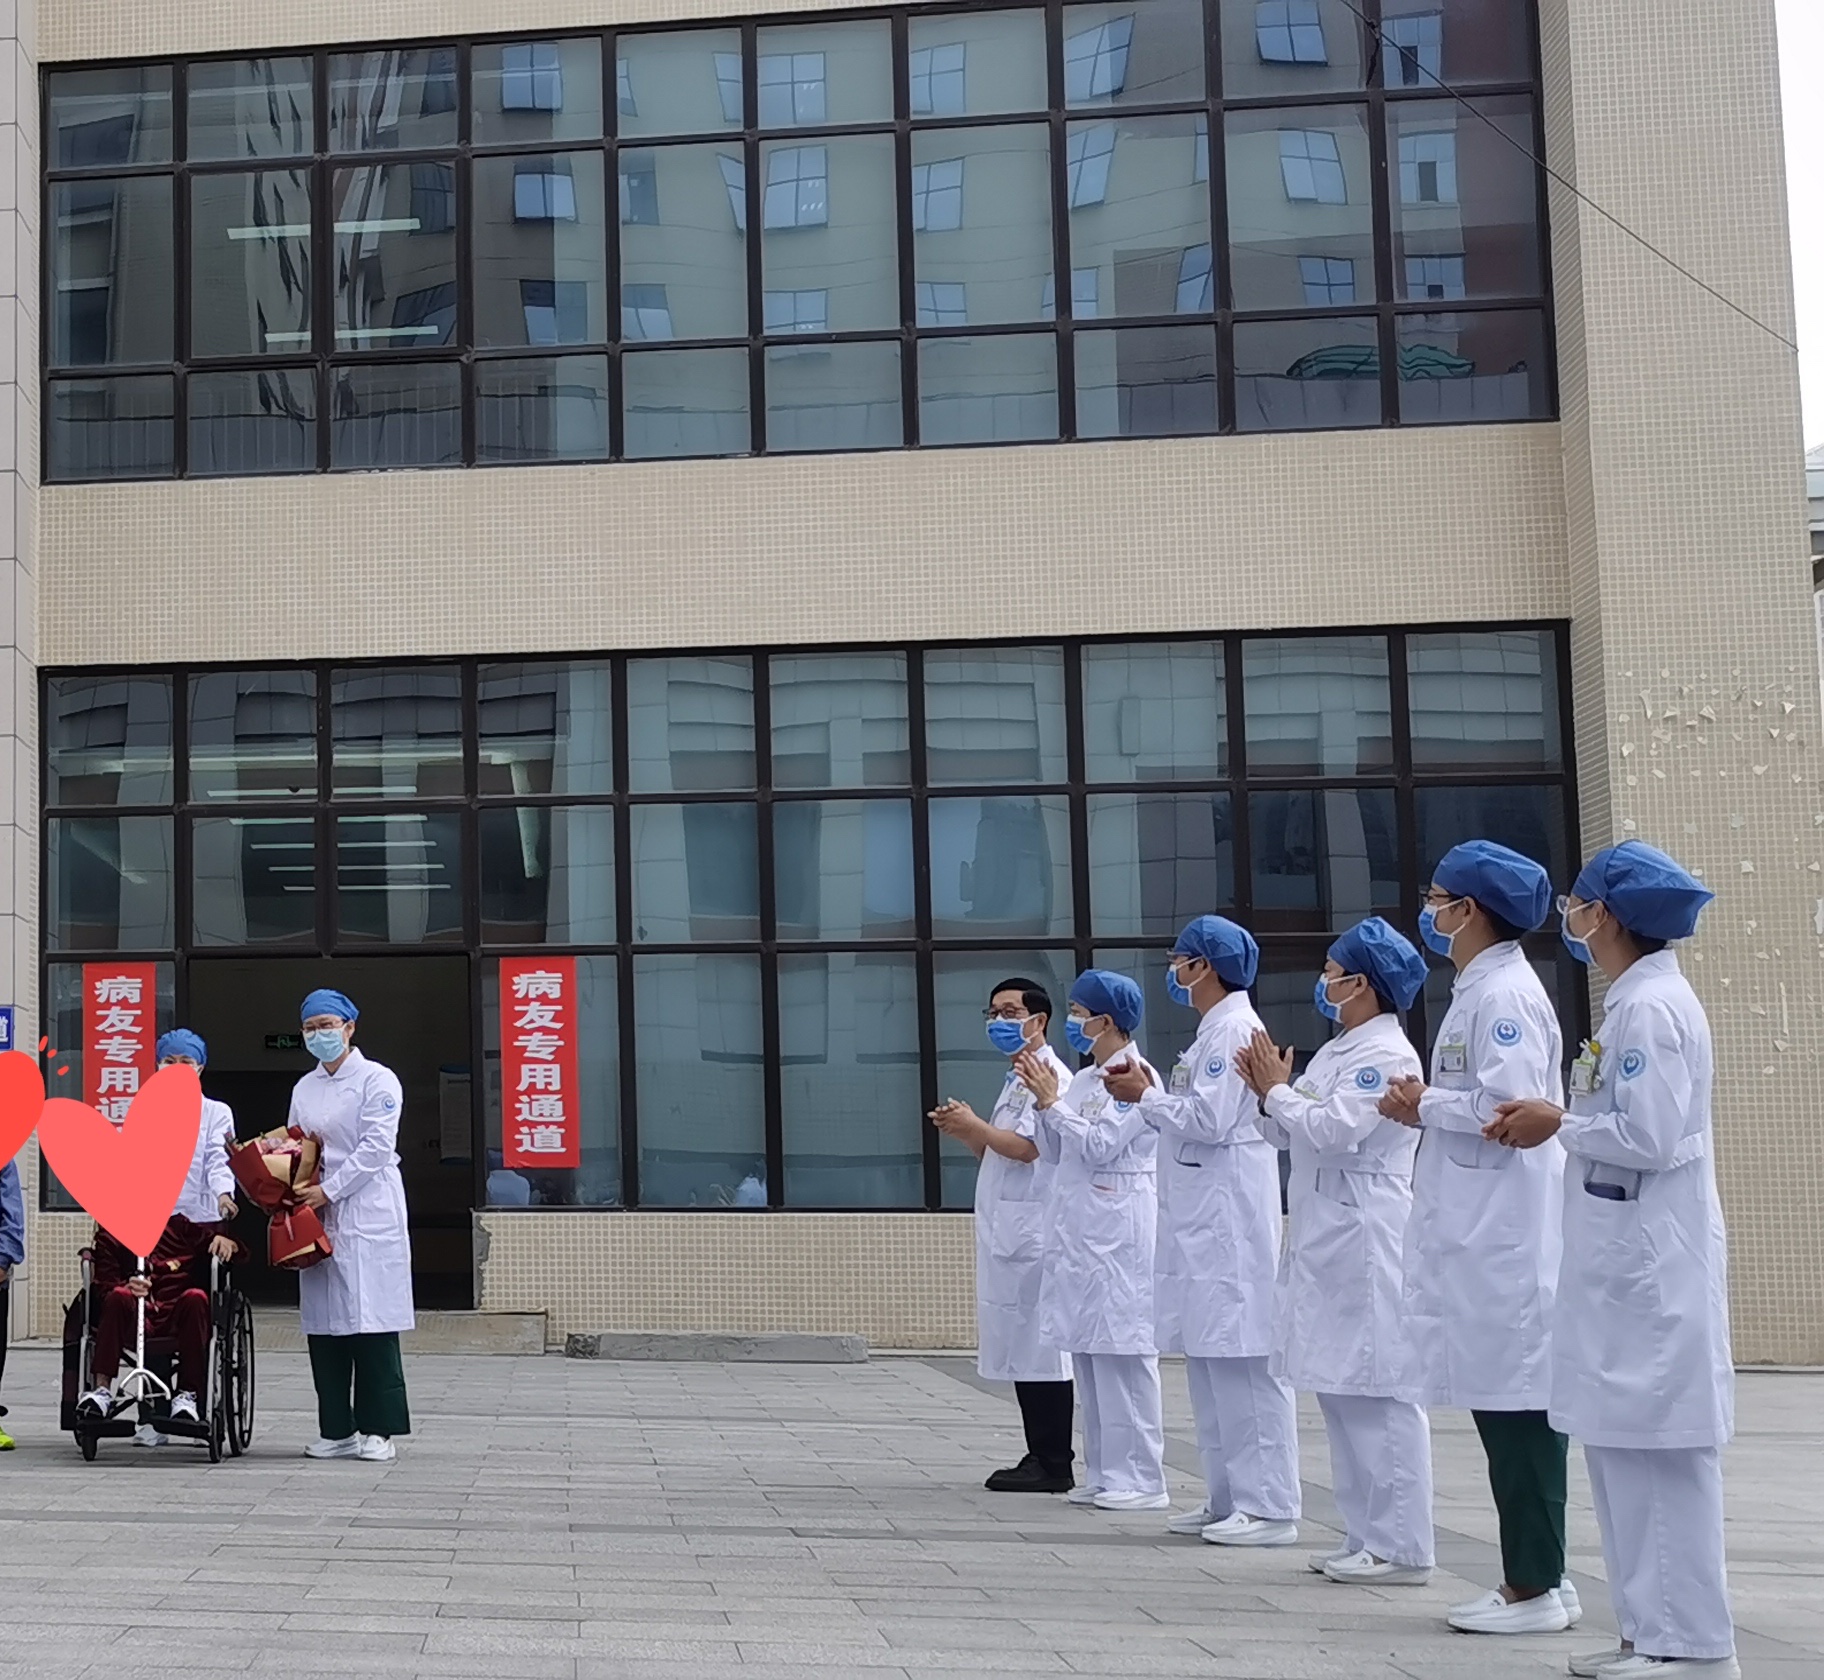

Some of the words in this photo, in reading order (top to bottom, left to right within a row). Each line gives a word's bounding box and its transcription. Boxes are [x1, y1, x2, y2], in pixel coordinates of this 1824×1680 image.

[512, 970, 567, 1153] 病友专用通道
